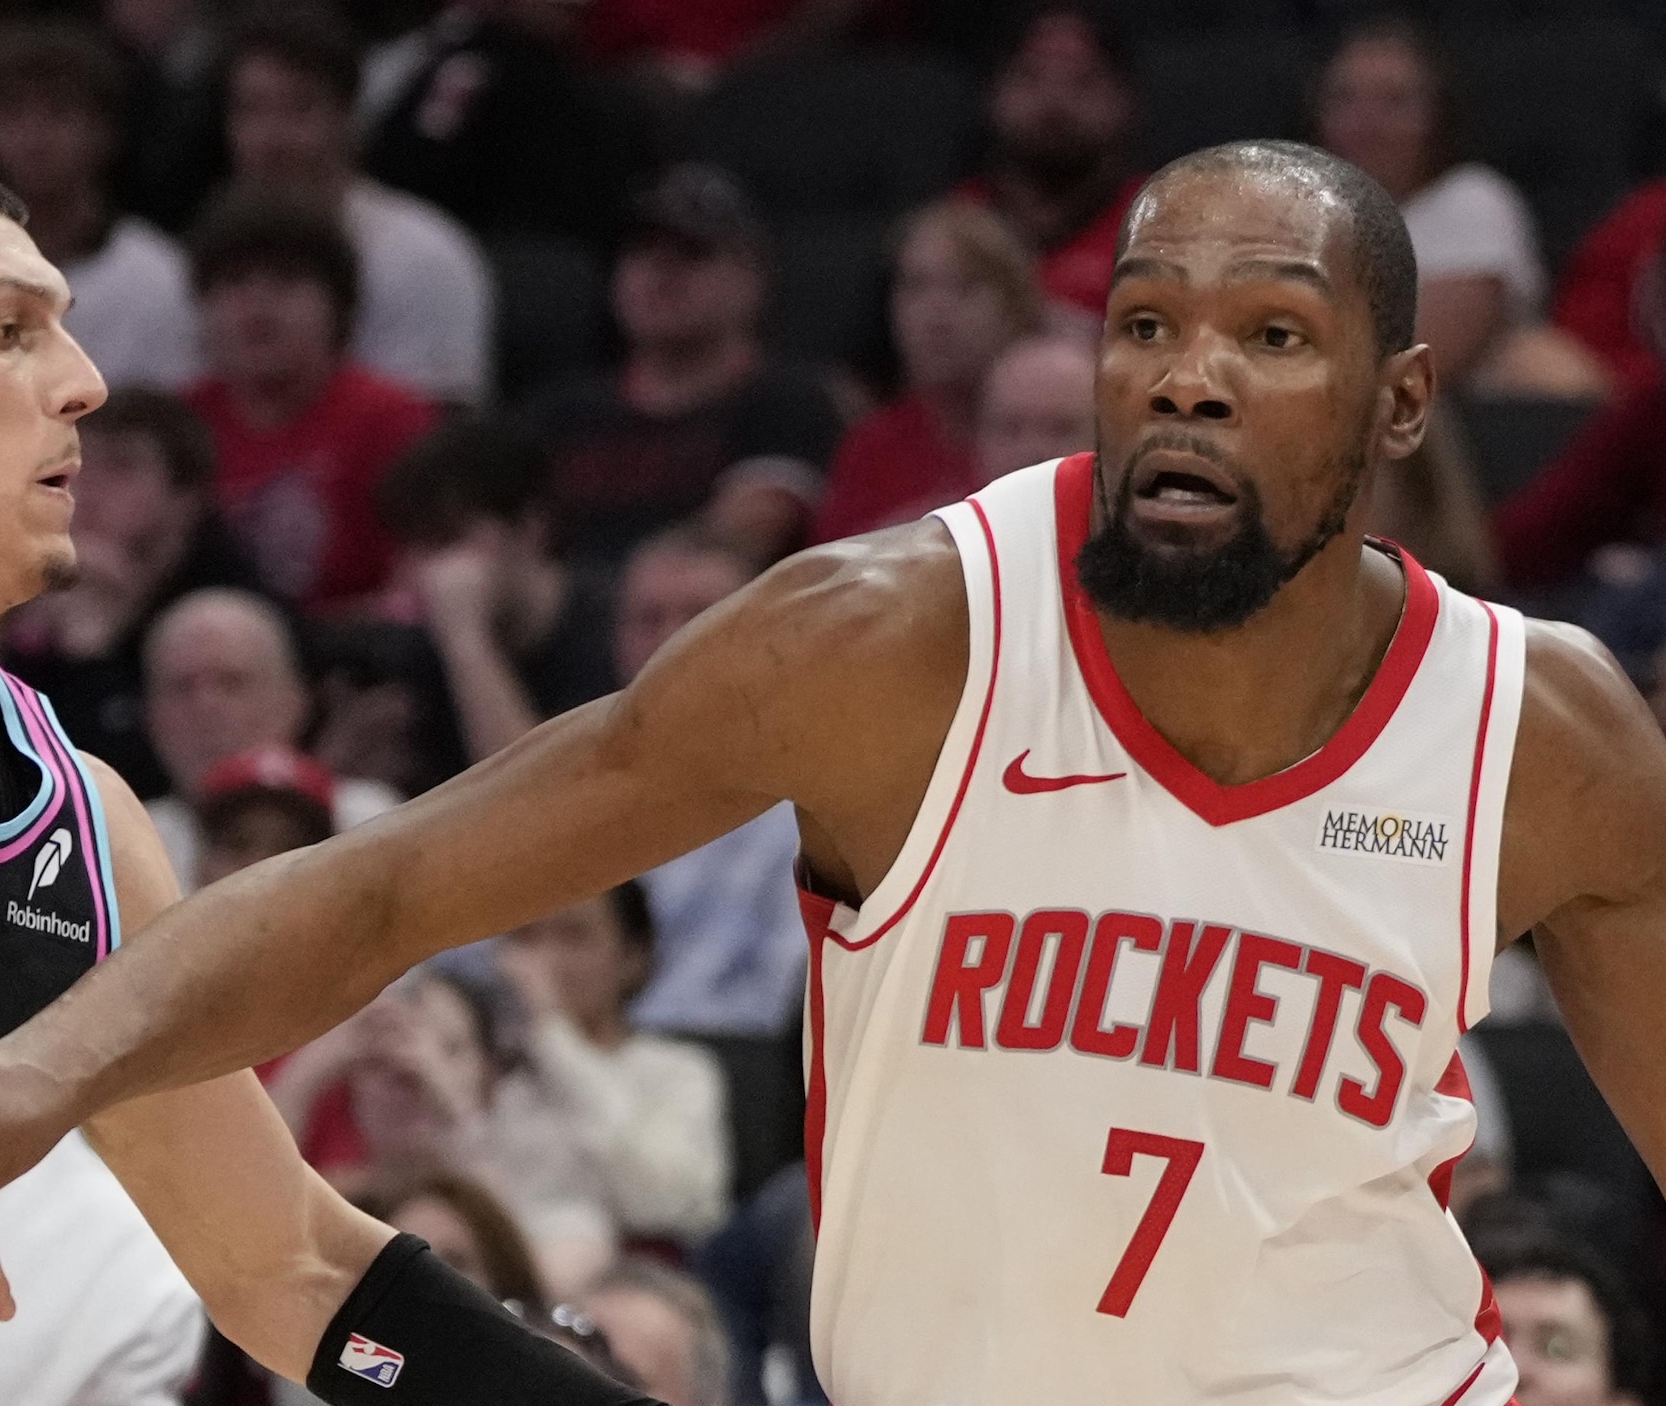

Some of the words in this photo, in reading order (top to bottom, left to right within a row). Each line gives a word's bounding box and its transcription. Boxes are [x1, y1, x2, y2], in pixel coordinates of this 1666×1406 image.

[1319, 826, 1448, 861] HERMANN
[1323, 810, 1449, 844] MEMORIAL
[6, 900, 91, 943] Robinhood
[919, 907, 1428, 1131] ROCKETS
[1096, 1127, 1205, 1319] 7
